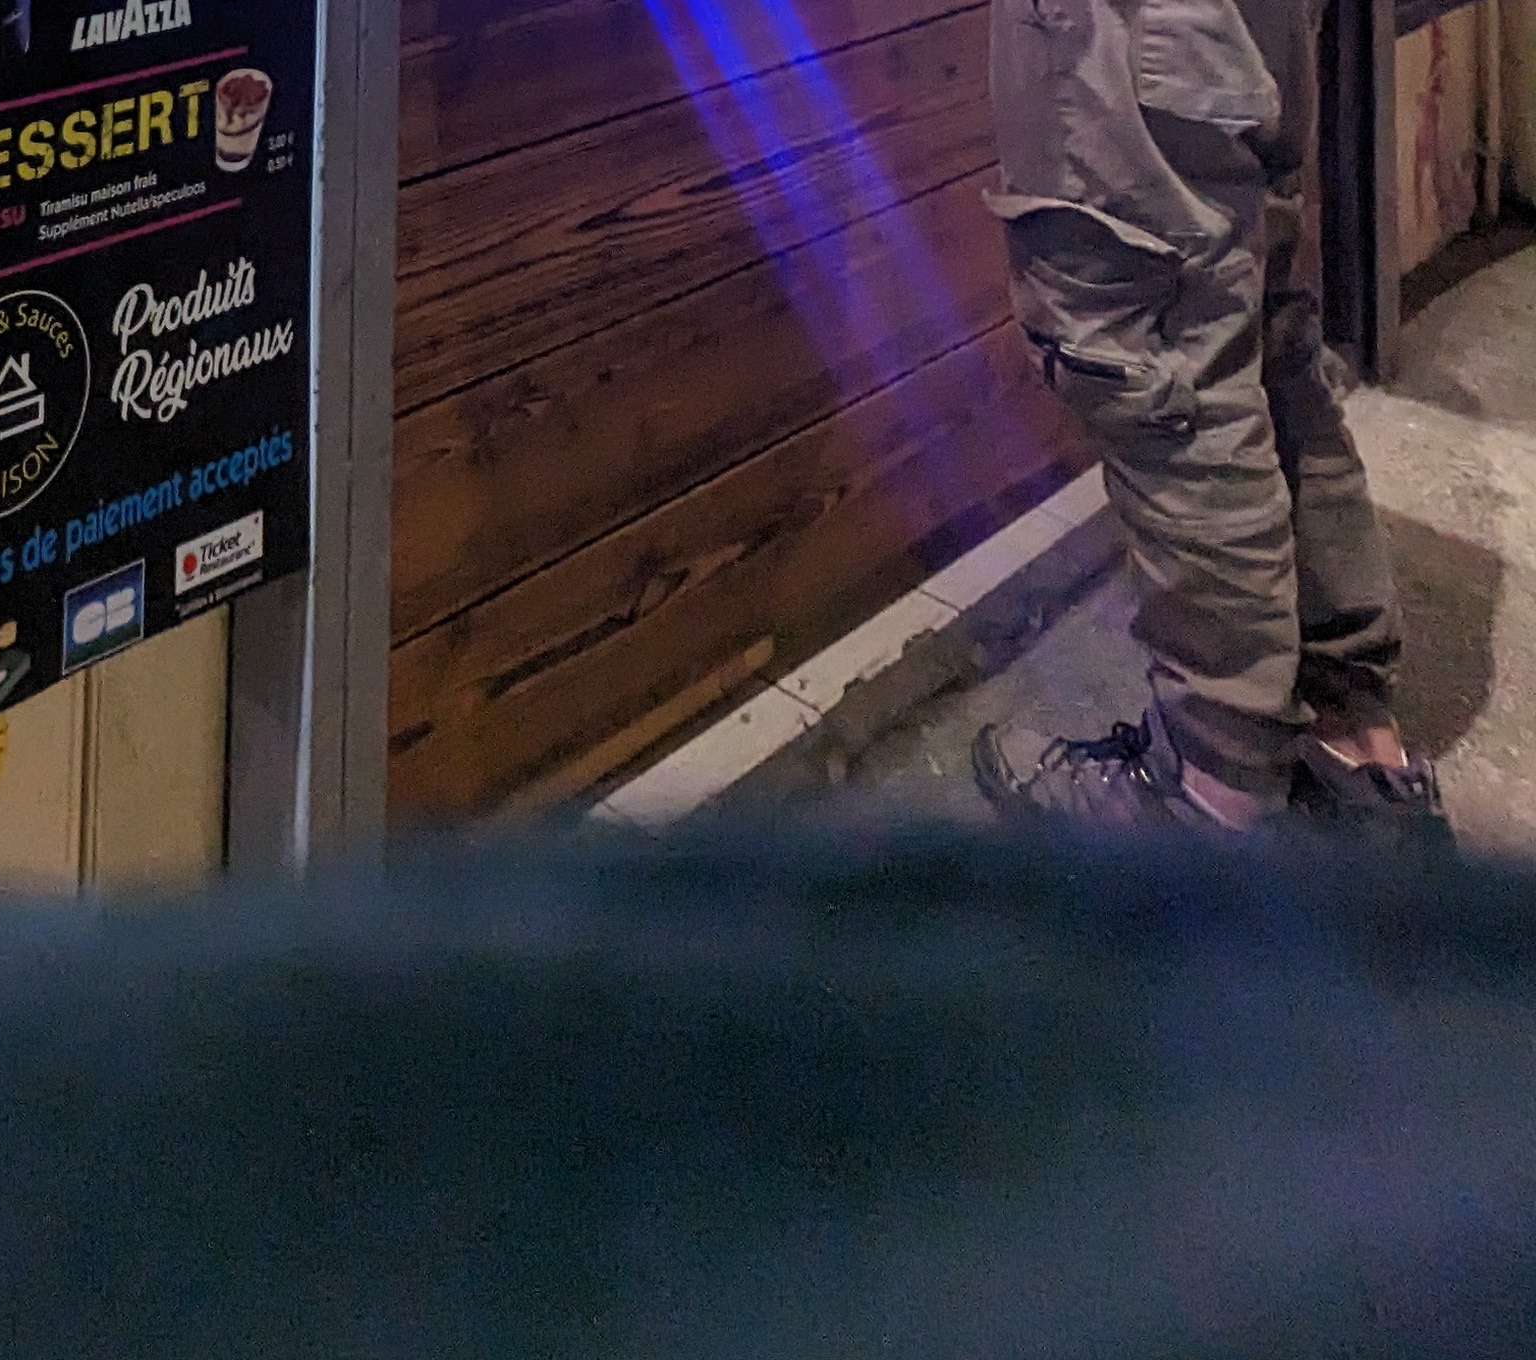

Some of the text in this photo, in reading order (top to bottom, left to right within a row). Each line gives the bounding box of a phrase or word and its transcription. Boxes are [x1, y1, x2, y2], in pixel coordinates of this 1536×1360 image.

[38, 209, 109, 242] Supplément
[39, 170, 159, 218] Tiramisu maison frais
[15, 302, 74, 359] Sauces
[111, 256, 257, 355] Produits
[111, 318, 295, 423] Régionaux
[22, 525, 58, 572] de
[64, 475, 183, 564] paiement
[189, 428, 294, 501] acceptés
